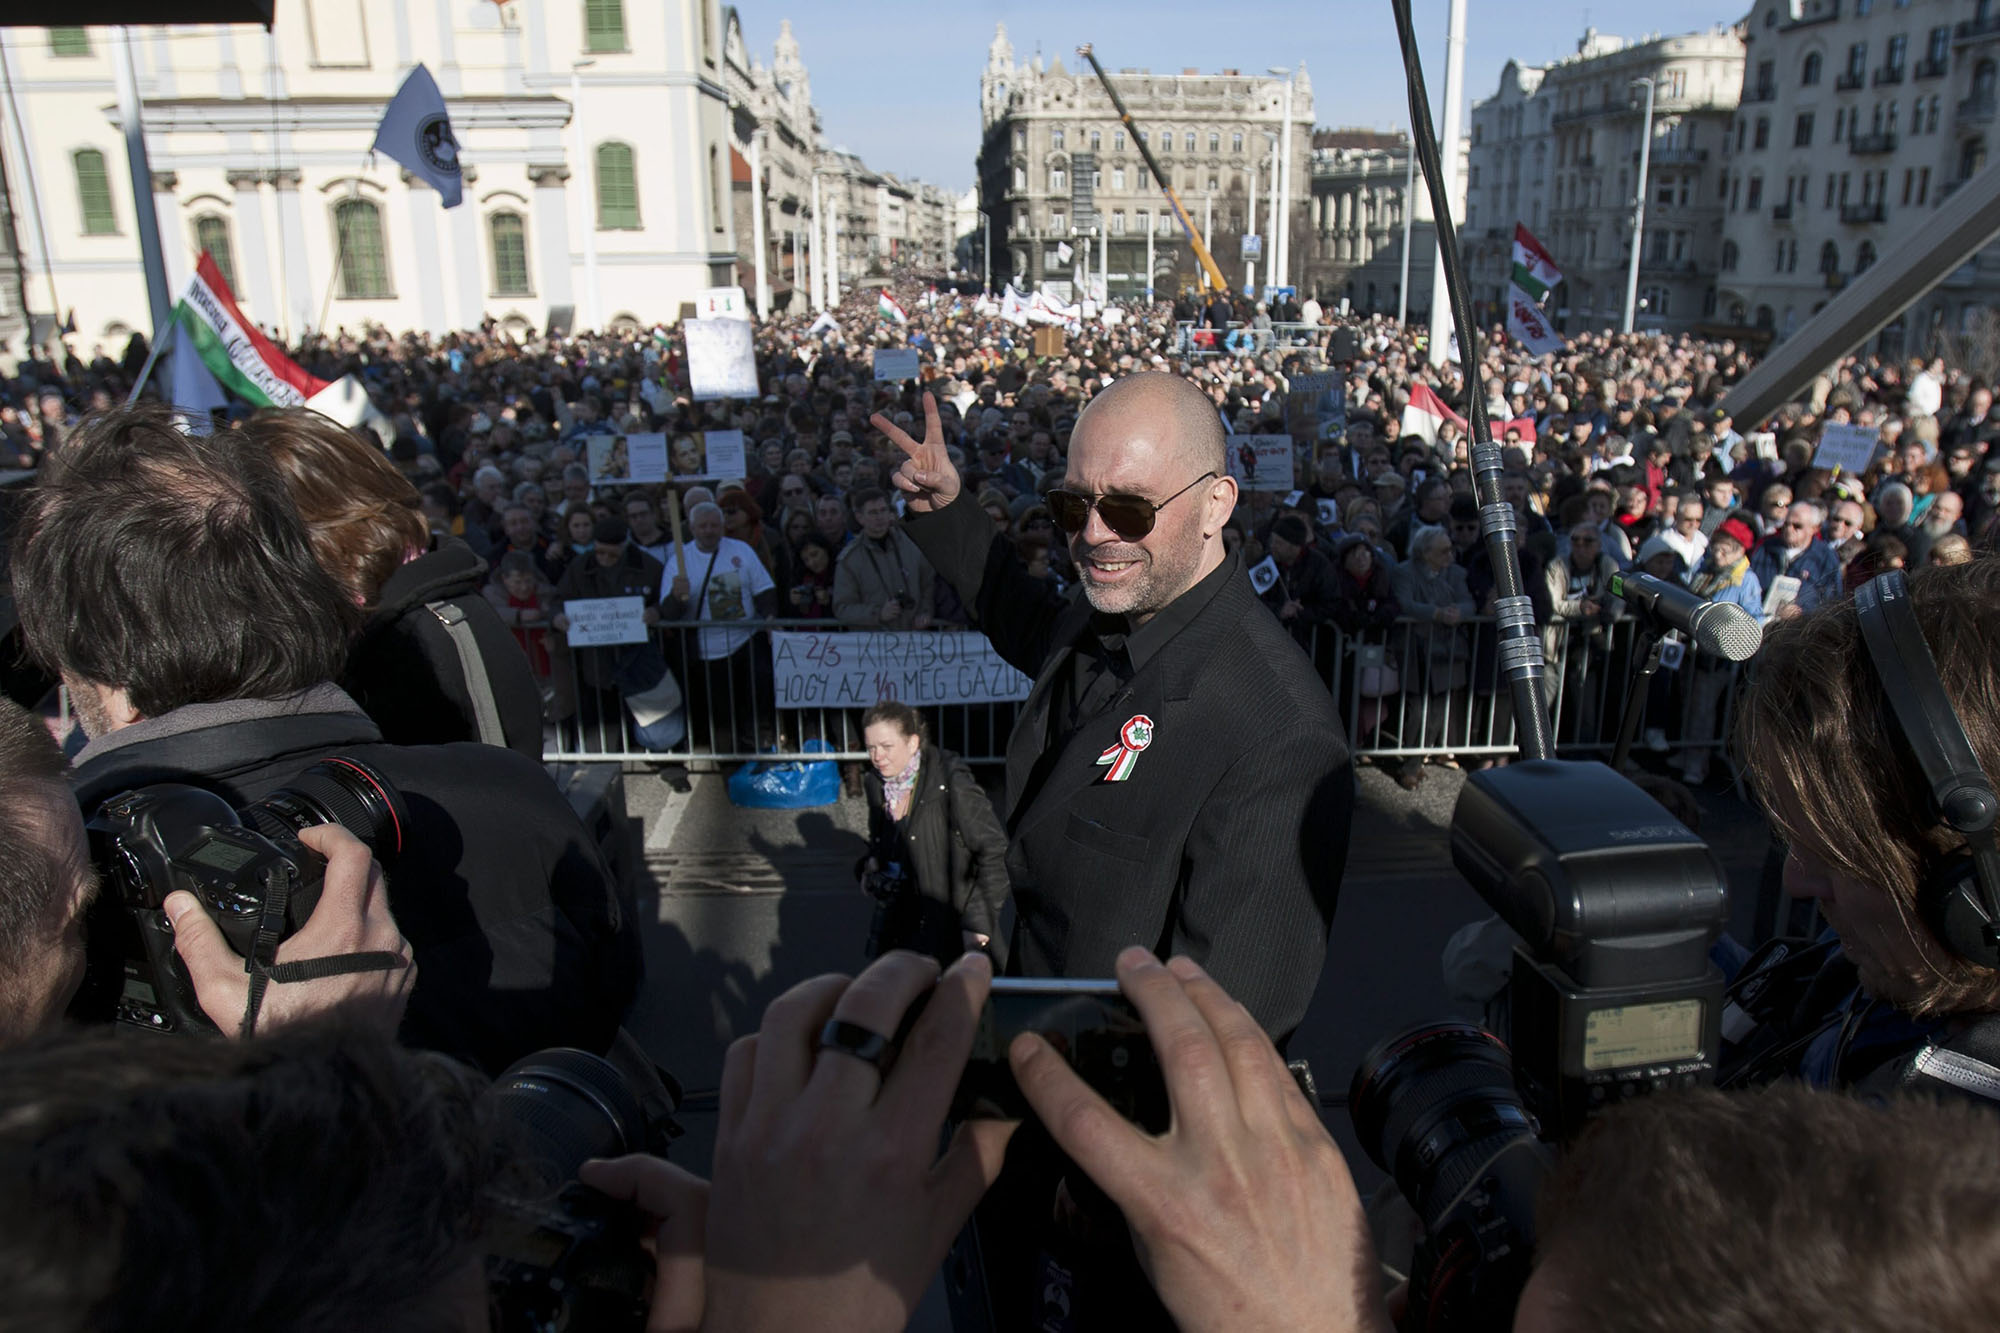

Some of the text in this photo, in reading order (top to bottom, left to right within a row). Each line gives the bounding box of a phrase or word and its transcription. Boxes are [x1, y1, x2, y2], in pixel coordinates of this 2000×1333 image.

[774, 638, 798, 669] A
[805, 633, 842, 668] 2/3
[774, 673, 830, 703] HOGY
[836, 672, 867, 703] AZ
[903, 668, 946, 701] MEG
